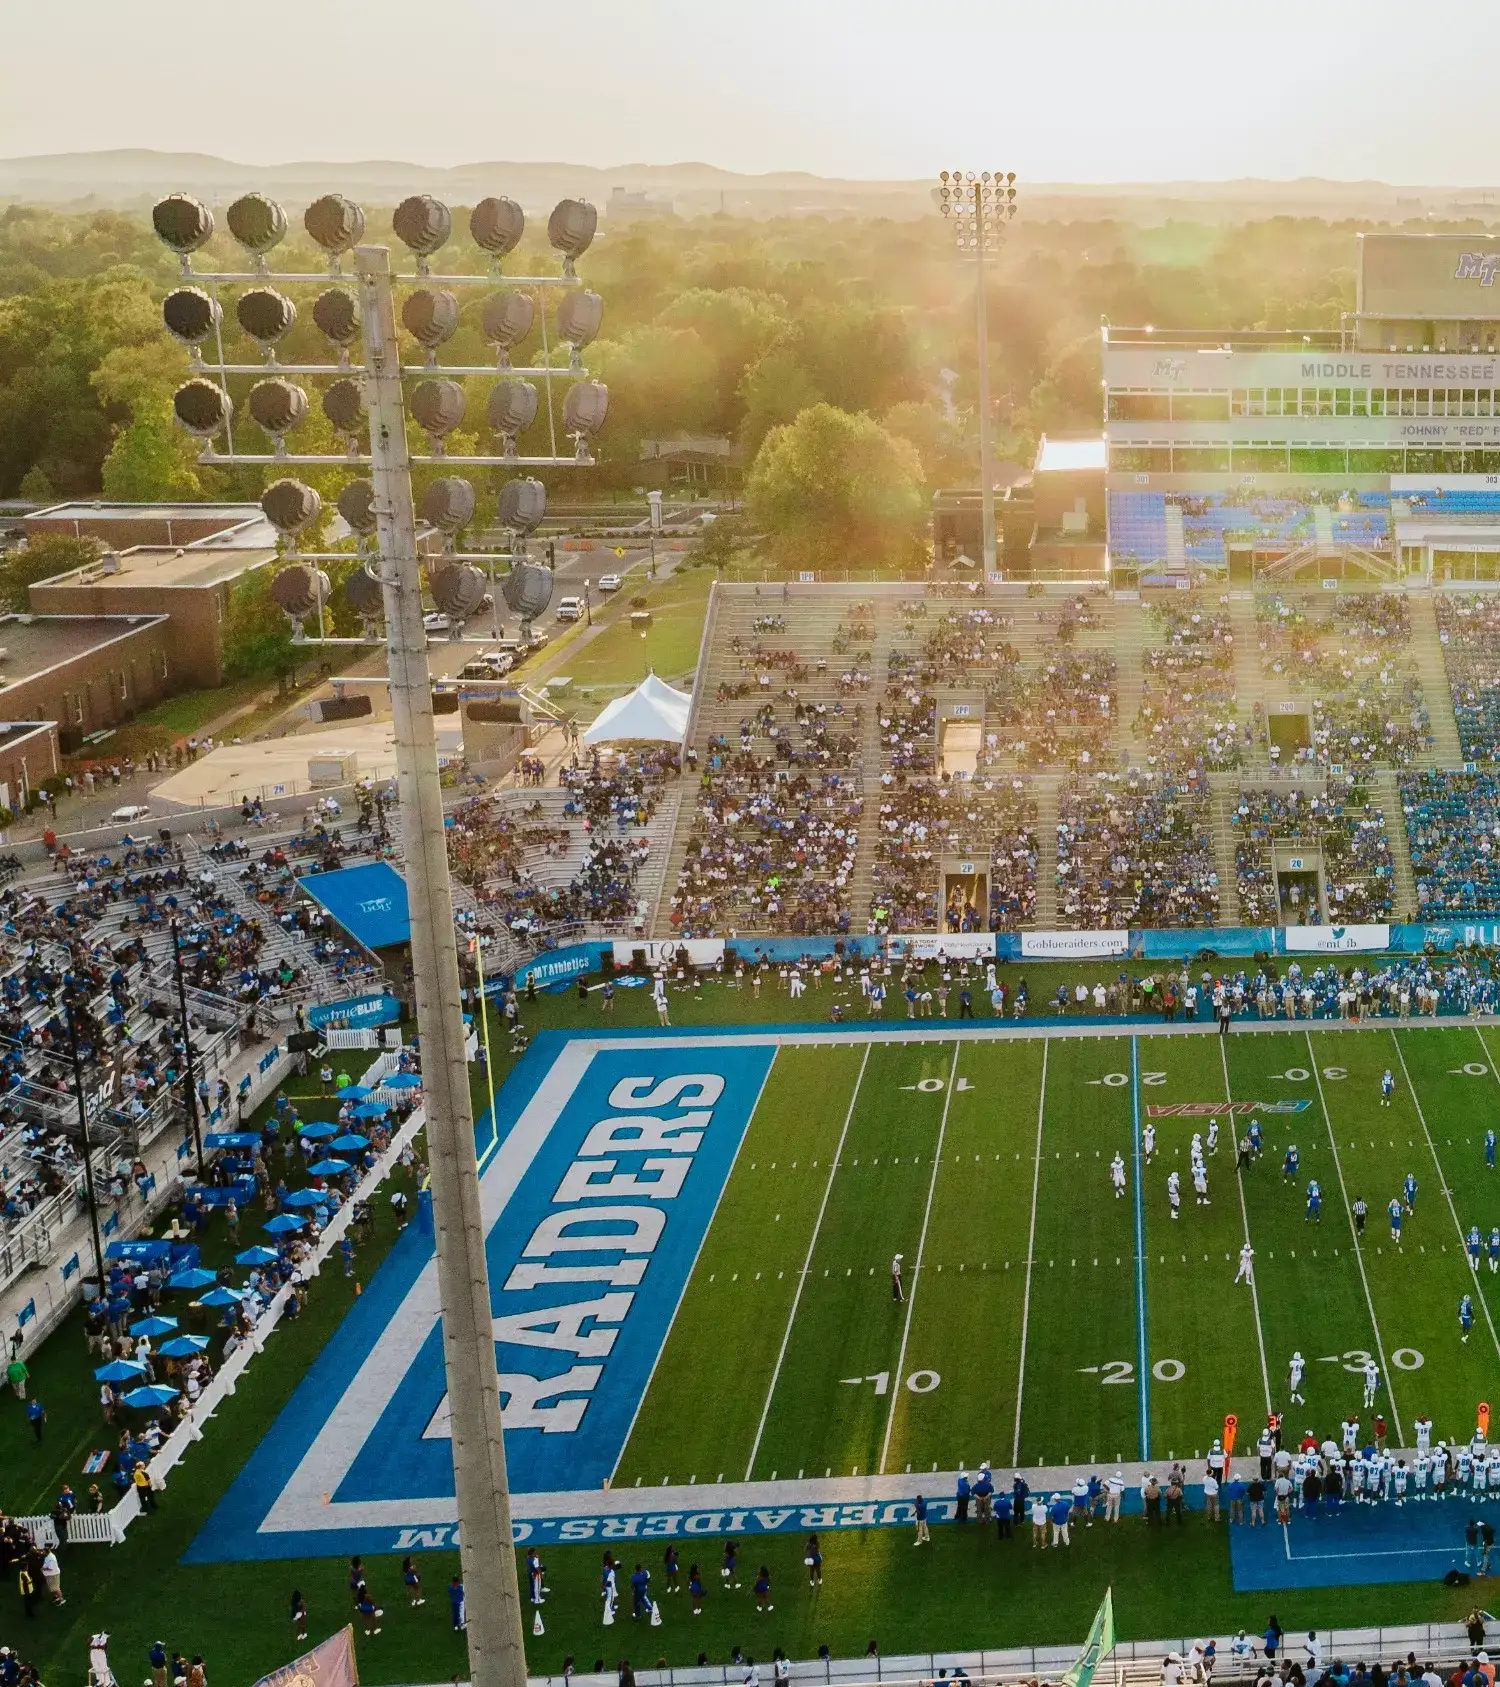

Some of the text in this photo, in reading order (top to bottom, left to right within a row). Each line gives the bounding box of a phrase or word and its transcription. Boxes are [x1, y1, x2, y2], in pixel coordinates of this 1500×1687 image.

[1301, 363, 1371, 379] MIDDLE
[1383, 364, 1494, 380] TENNESSEE
[1400, 425, 1448, 437] JOHNNY
[1485, 476, 1498, 484] 303
[962, 864, 973, 872] 2P
[1292, 860, 1302, 868] 2Q
[1027, 938, 1123, 950] Goblueraiders.com
[1103, 1072, 1168, 1086] 20
[1284, 1066, 1348, 1082] 30
[917, 1077, 975, 1093] 10
[421, 1073, 726, 1440] RAIDERS
[1343, 1348, 1424, 1373] 30
[1102, 1357, 1186, 1384] 20
[866, 1369, 941, 1395] 10
